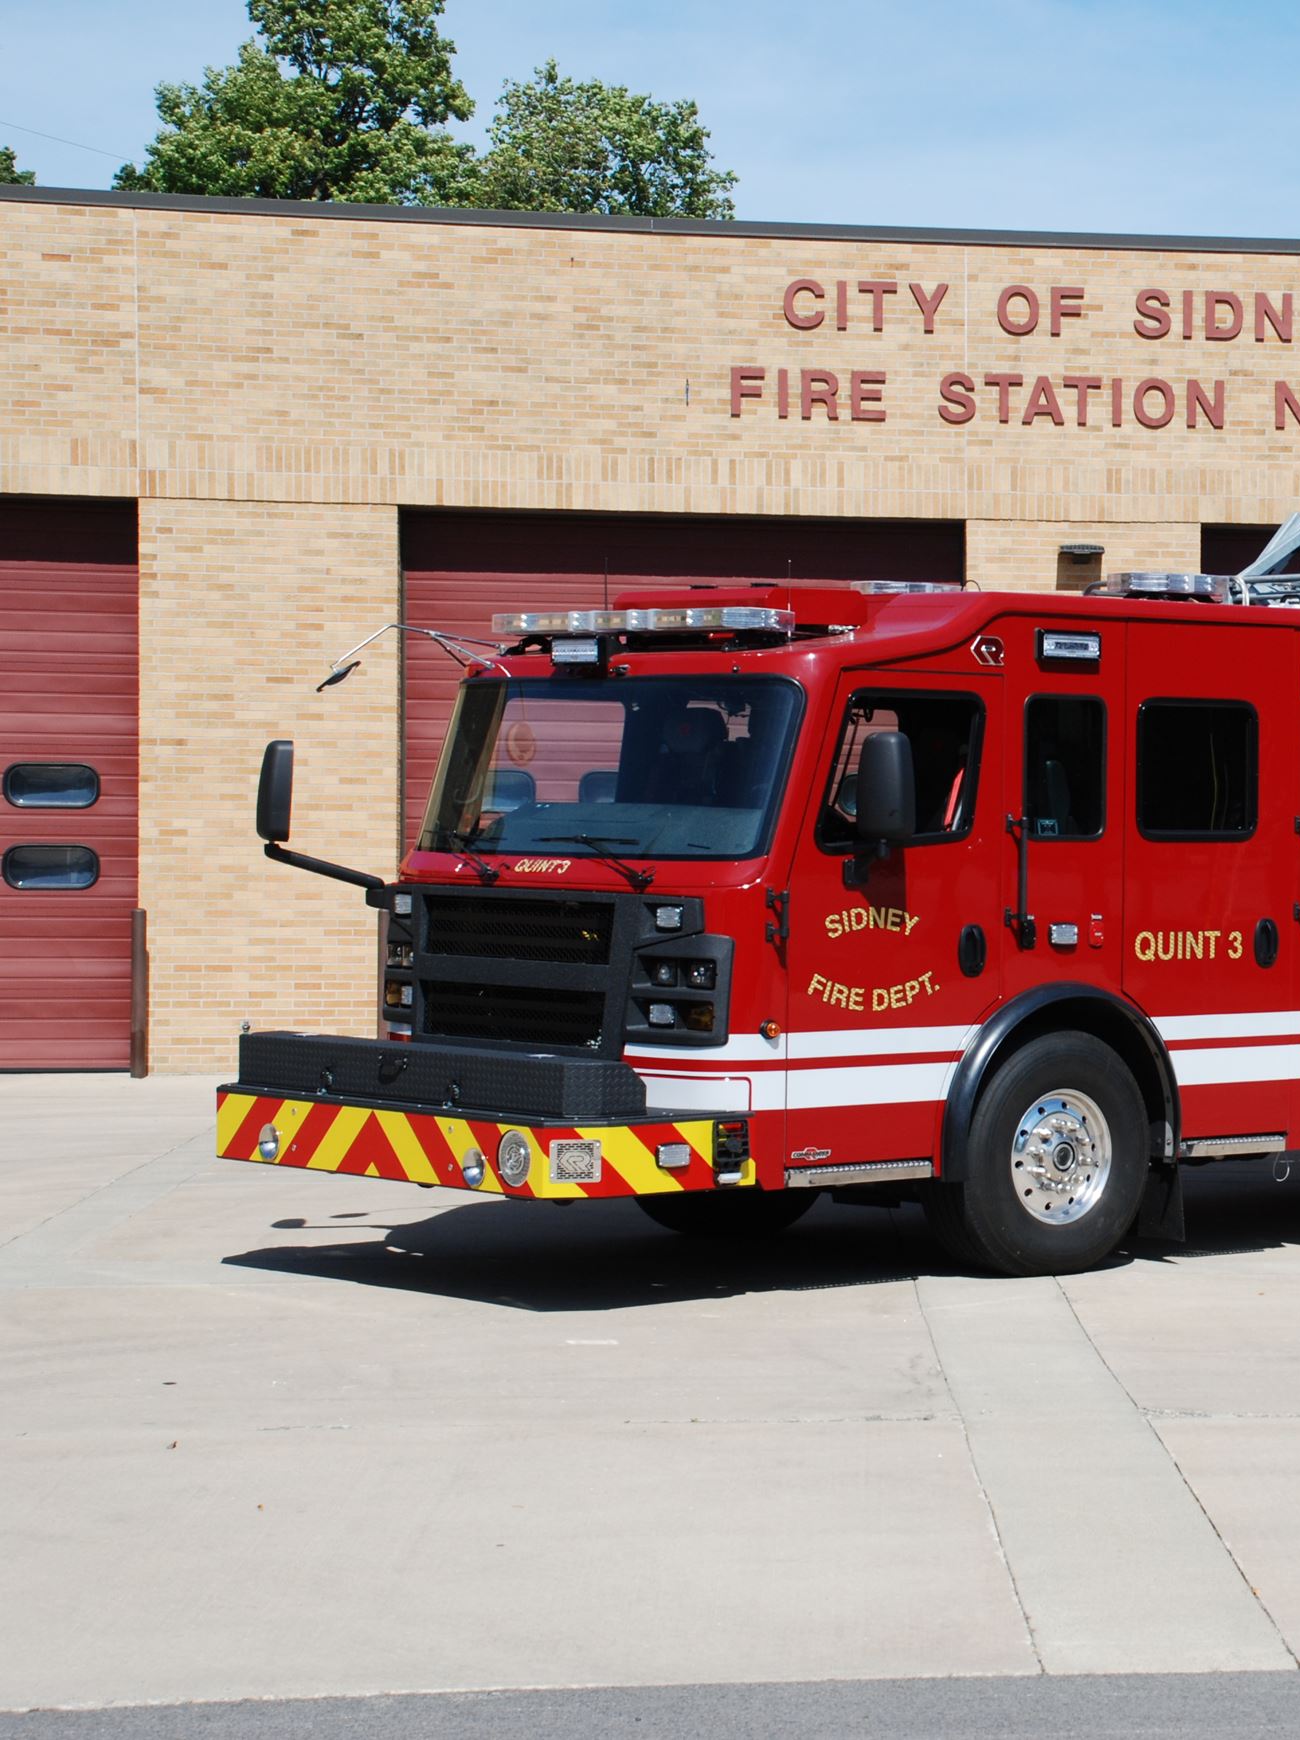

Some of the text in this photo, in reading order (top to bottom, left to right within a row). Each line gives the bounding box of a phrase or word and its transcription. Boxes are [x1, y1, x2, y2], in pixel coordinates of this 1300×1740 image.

[783, 278, 949, 334] CITY
[997, 284, 1085, 337] OF
[730, 366, 887, 422] FIRE
[938, 371, 1225, 430] STATION
[824, 906, 920, 939] SIDNEY
[1134, 930, 1243, 962] QUINT 3
[807, 970, 941, 1012] FIRE DEPT.
